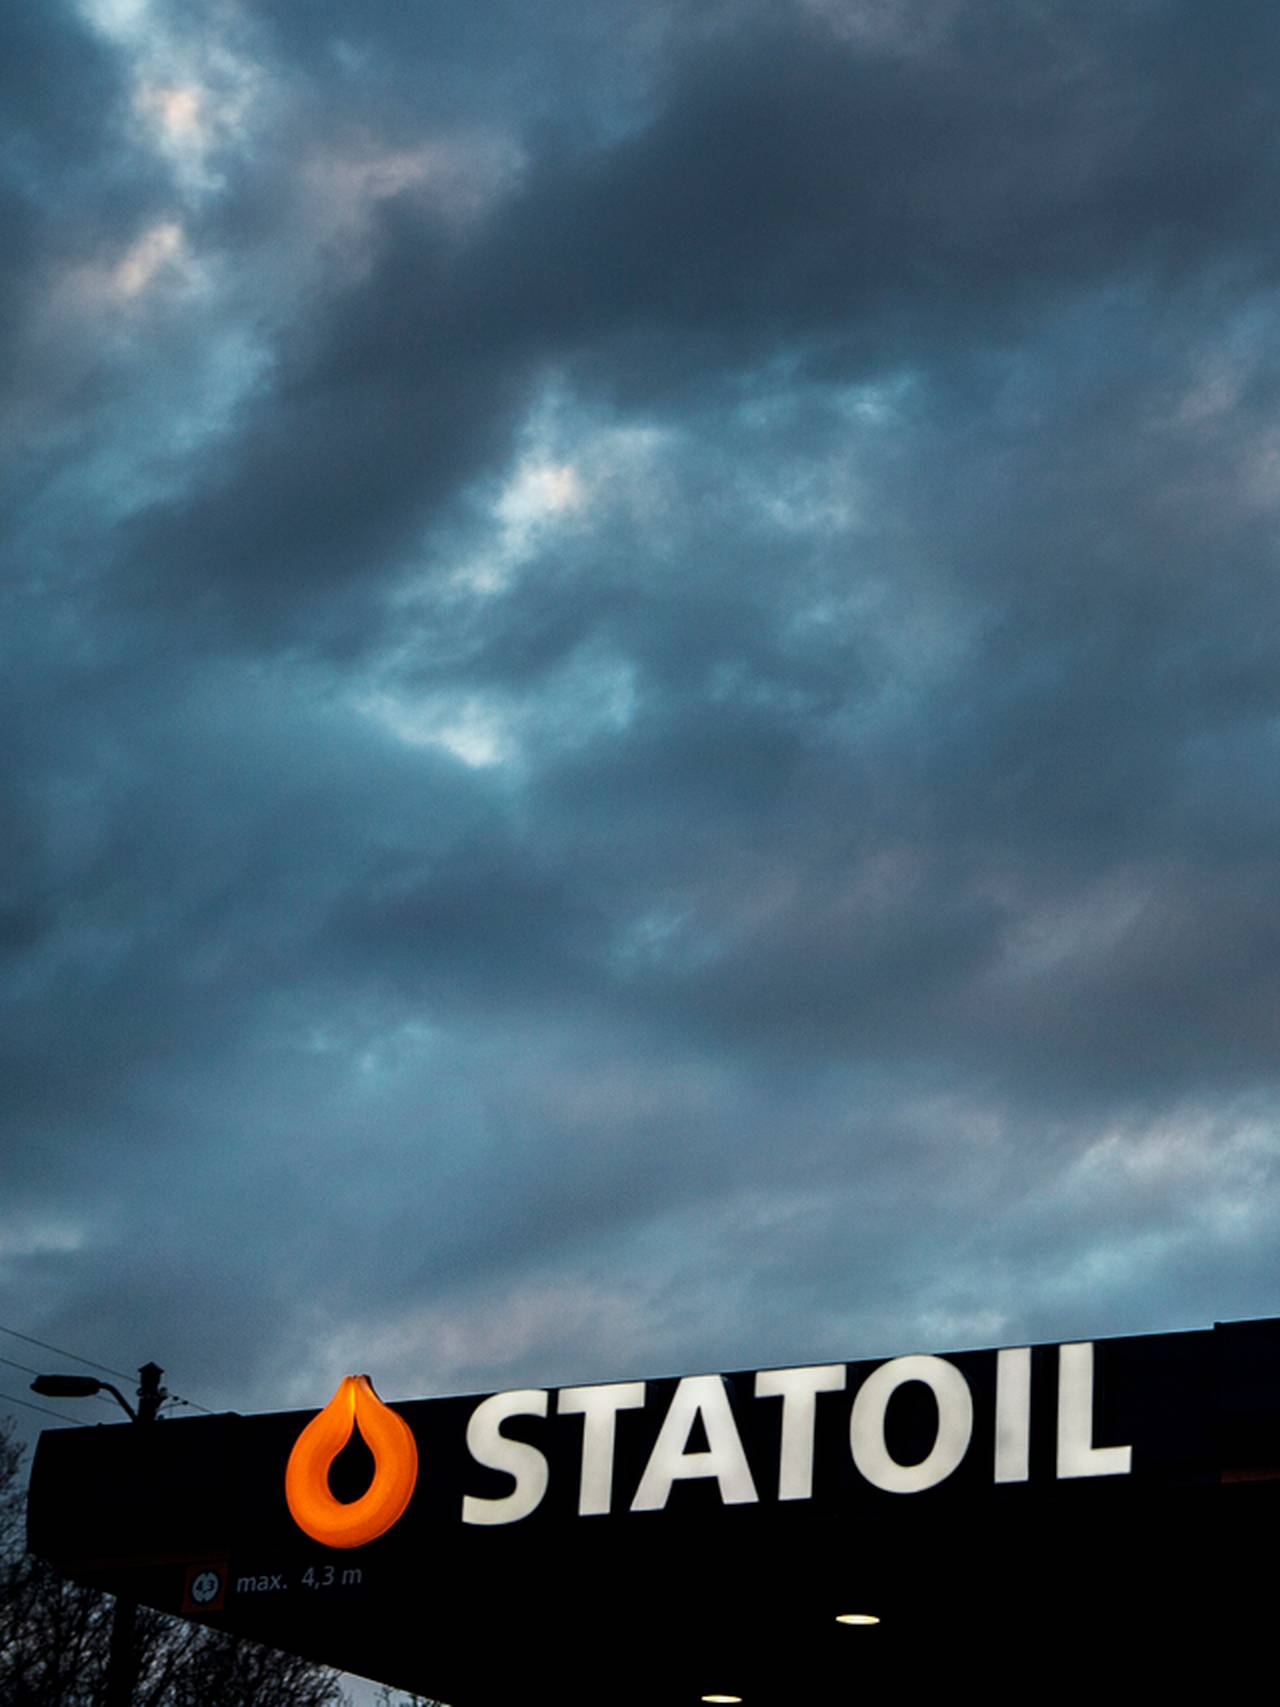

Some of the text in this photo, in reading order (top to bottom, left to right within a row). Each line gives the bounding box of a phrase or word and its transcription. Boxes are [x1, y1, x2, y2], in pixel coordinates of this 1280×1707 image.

[461, 1341, 1133, 1526] STATOIL
[236, 1565, 363, 1593] max. 4,3 m
